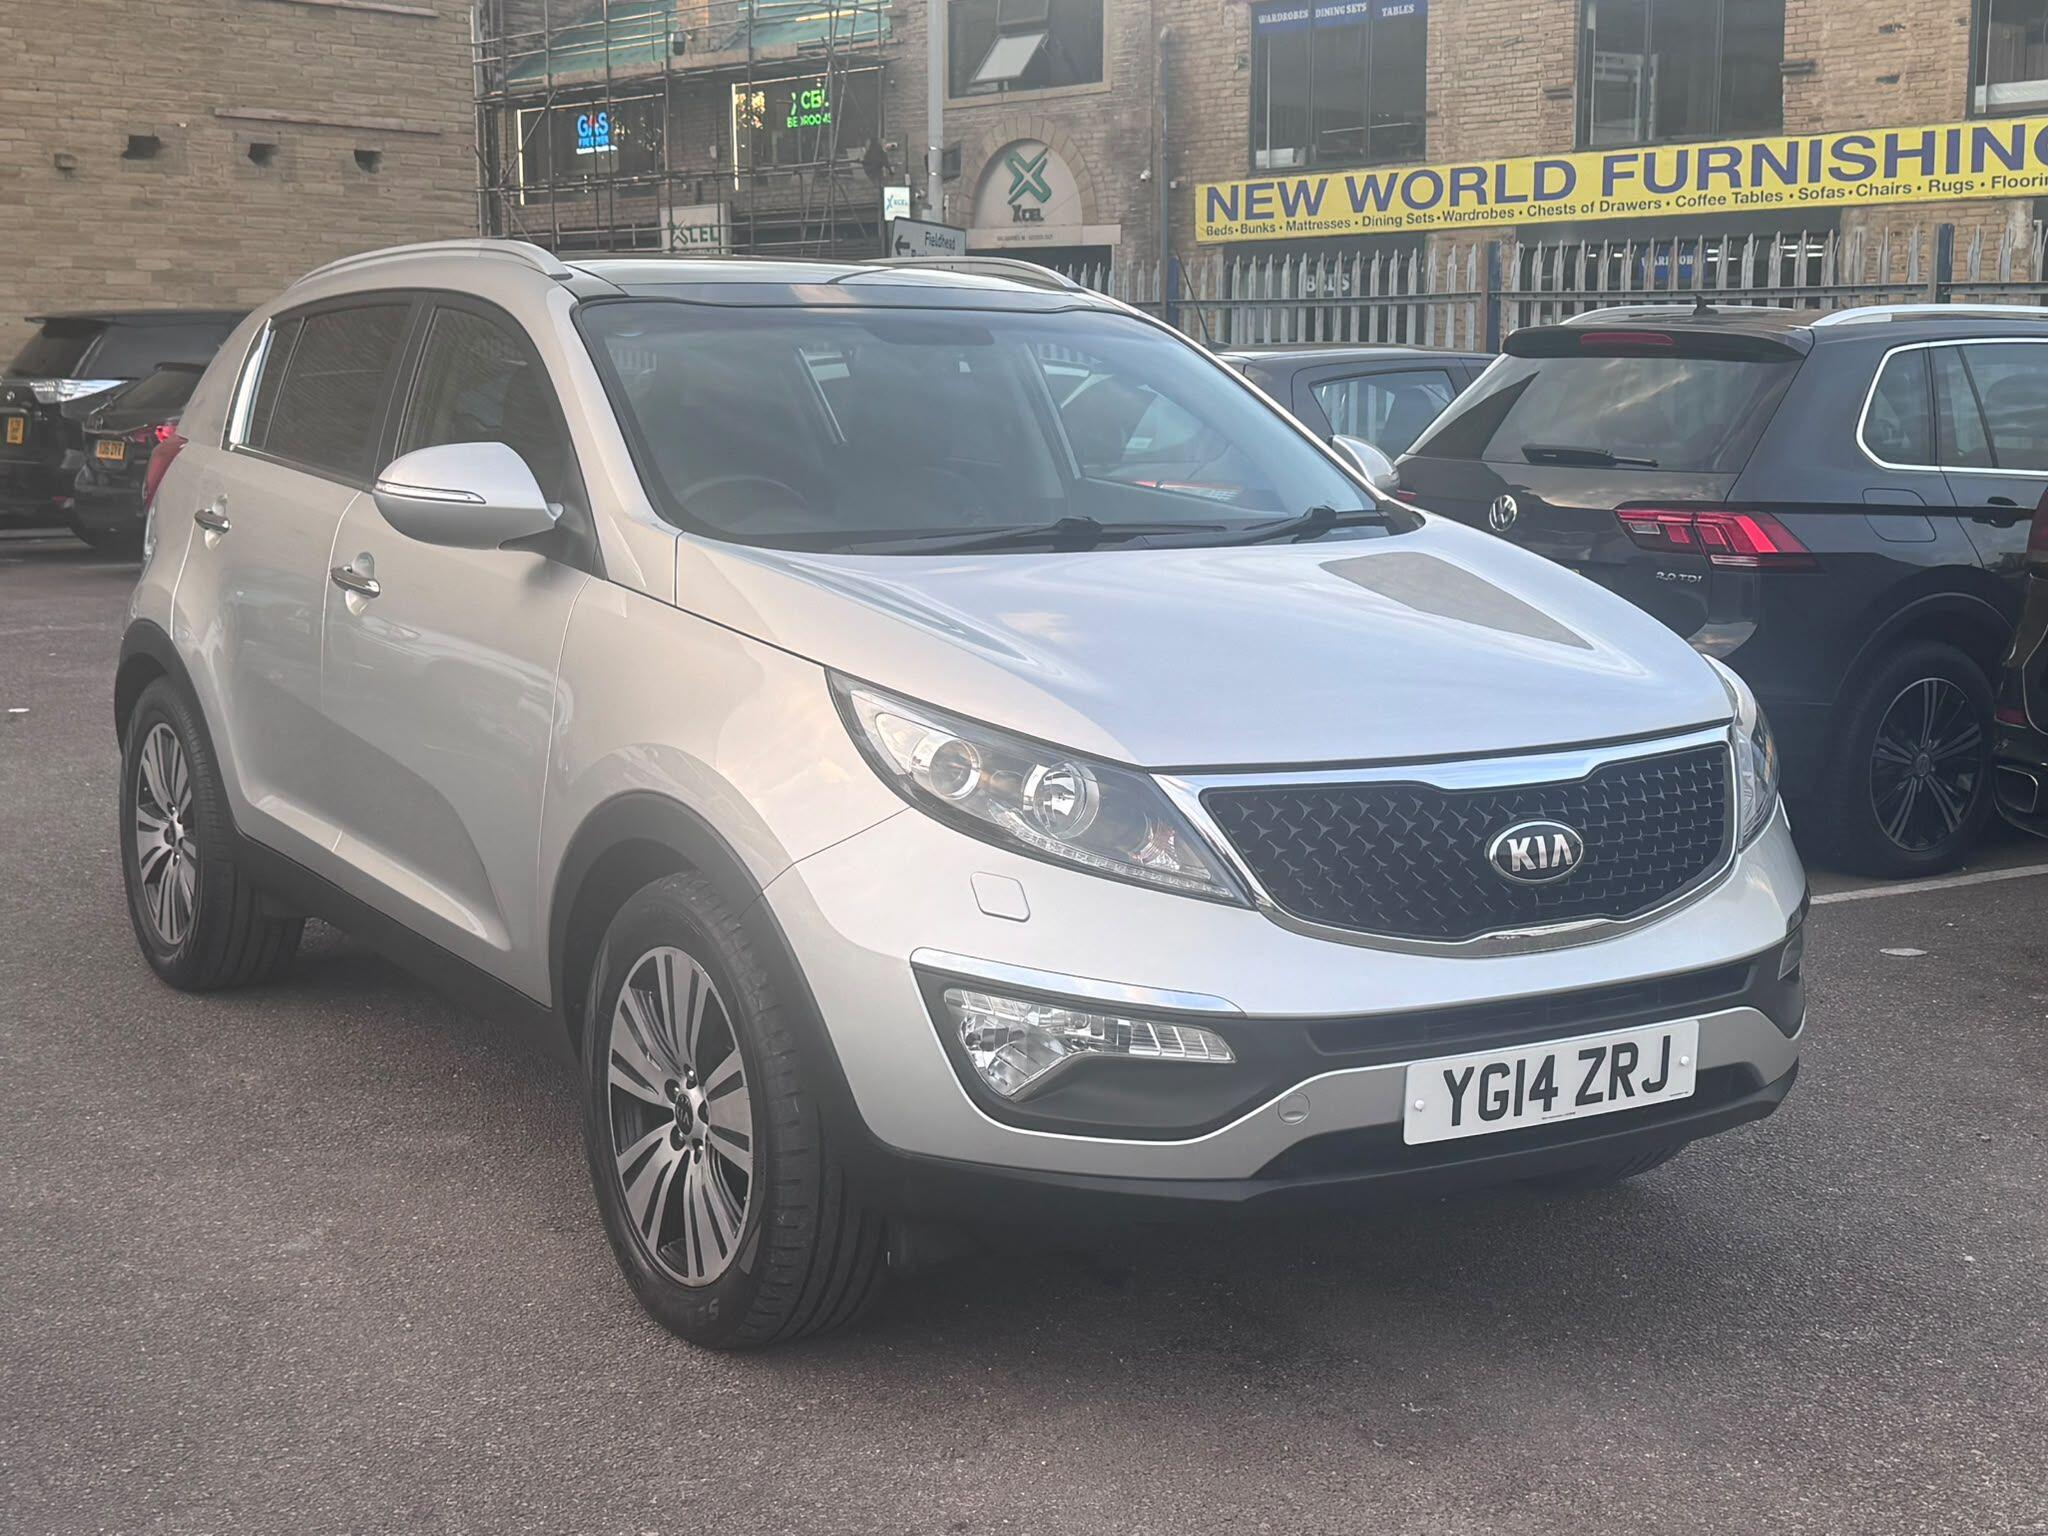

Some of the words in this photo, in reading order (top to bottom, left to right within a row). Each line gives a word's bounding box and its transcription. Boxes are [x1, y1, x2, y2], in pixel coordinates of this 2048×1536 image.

[1258, 9, 1309, 25] WARDROBES
[1315, 6, 1346, 19] DINING
[1346, 3, 1368, 14] SETS
[1381, 4, 1415, 17] TABLES
[1206, 178, 1328, 222] NEW
[1345, 159, 1577, 213] WORLD
[1206, 225, 1234, 236] Beds
[1240, 222, 1276, 235] Bunks
[1286, 217, 1351, 232] Mattresses
[1362, 214, 1402, 226] Dining
[1406, 211, 1435, 224] Sets
[1442, 208, 1515, 222] Wardrobes
[1527, 204, 1576, 217] Chests
[1581, 201, 1595, 213] of
[1599, 198, 1662, 213] Drawers
[1675, 193, 1727, 208] Coffee
[1732, 190, 1783, 205] Tables
[1798, 186, 1845, 201] Sofas
[1856, 182, 1912, 197] Chairs
[1928, 178, 1974, 194] Rugs
[925, 231, 956, 250] Fieldhead
[1306, 272, 1350, 292] BS
[1679, 573, 1702, 582] TDI
[1507, 833, 1574, 872] KIA
[1443, 1054, 1558, 1127] YG14
[1575, 1035, 1671, 1107] ZRJ
